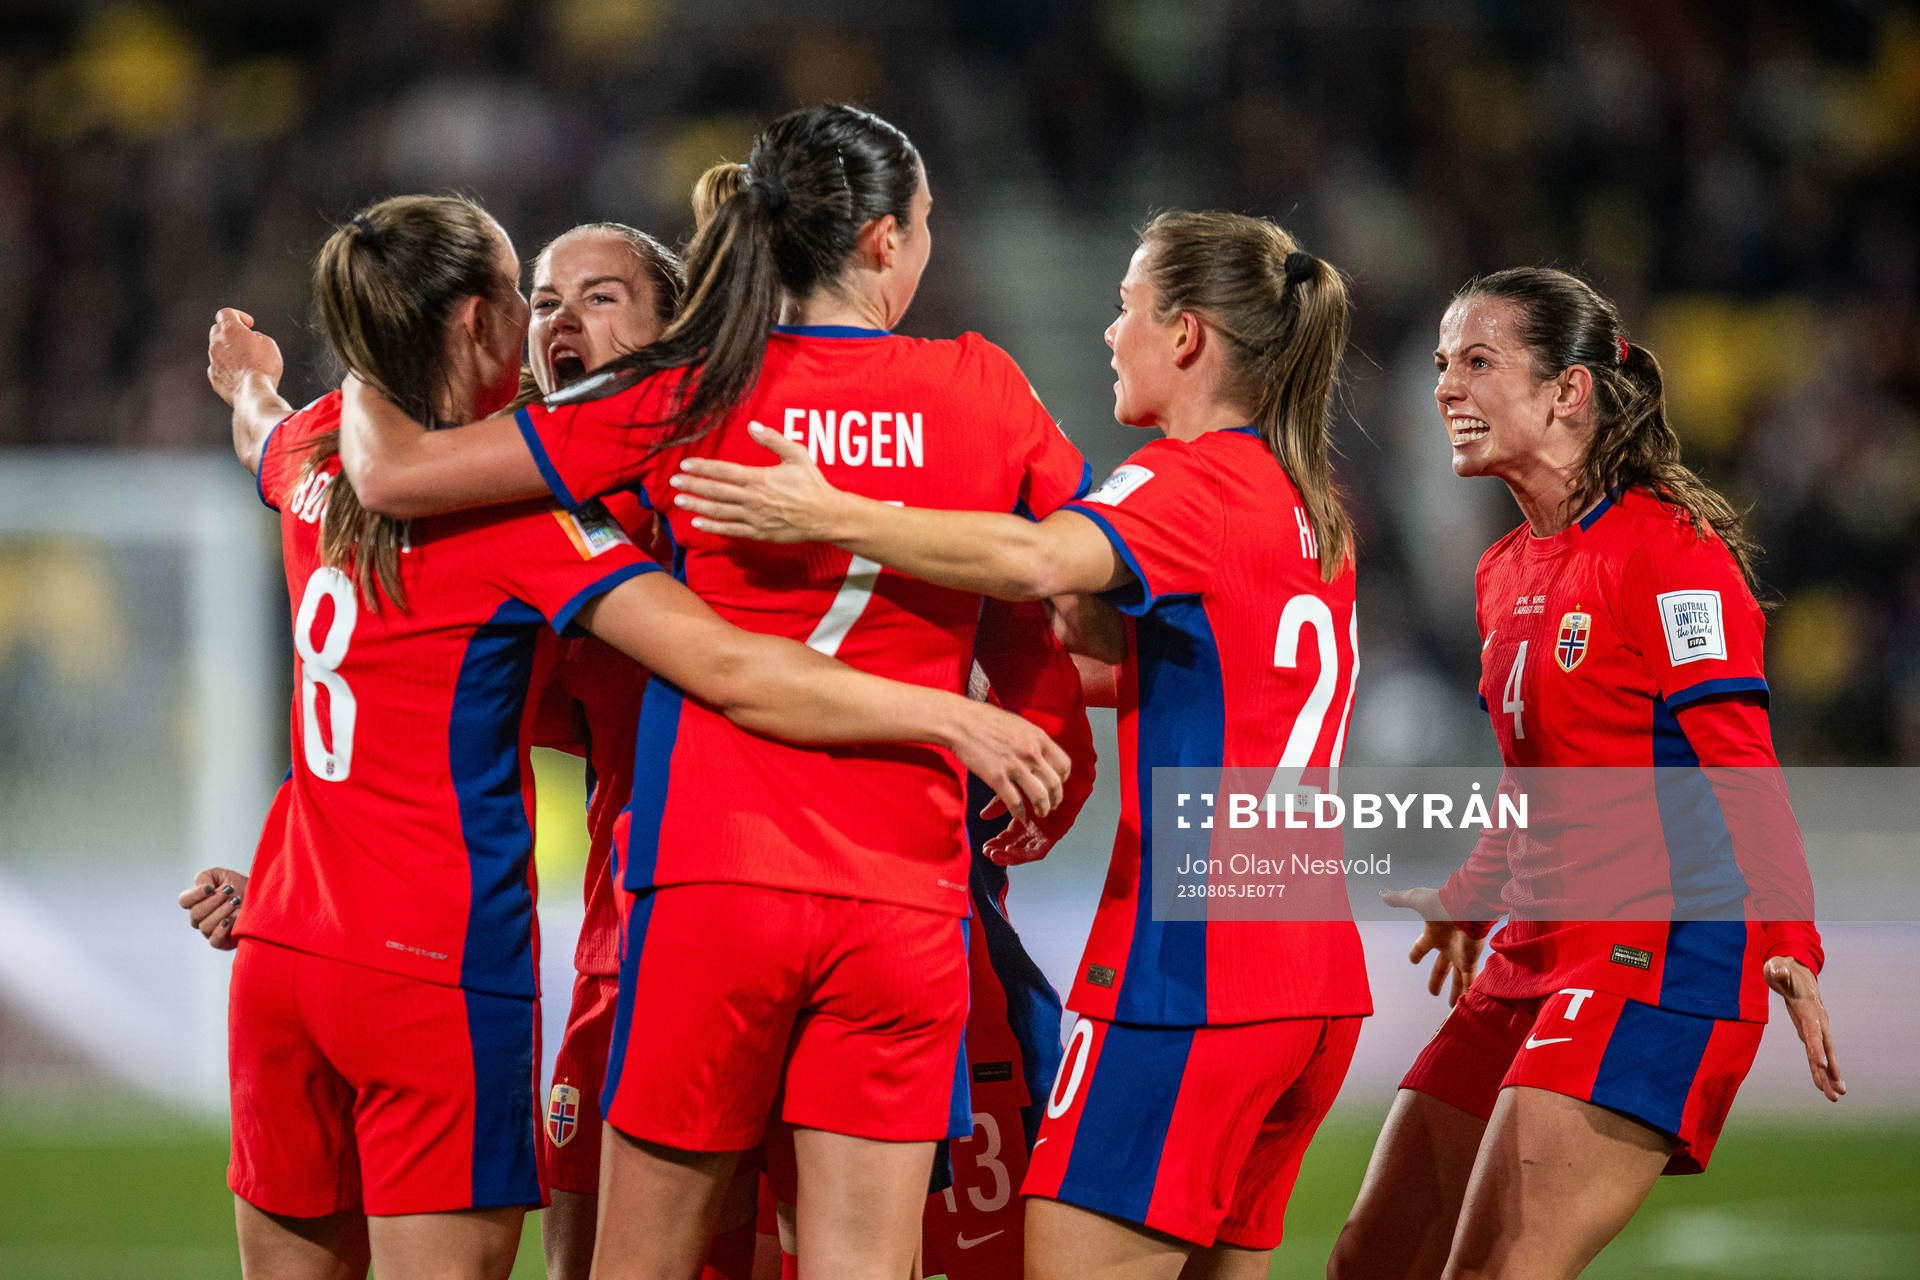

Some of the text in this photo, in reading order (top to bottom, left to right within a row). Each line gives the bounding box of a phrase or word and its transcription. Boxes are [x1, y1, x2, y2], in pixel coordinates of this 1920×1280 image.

[783, 408, 924, 468] ENGEN
[1294, 506, 1318, 559] H
[1673, 602, 1708, 613] FOOTBALL
[1675, 612, 1709, 626] UNITES
[1676, 624, 1713, 638] the World
[1689, 638, 1705, 647] FIFA
[294, 566, 357, 782] 8
[1502, 640, 1528, 739] 4
